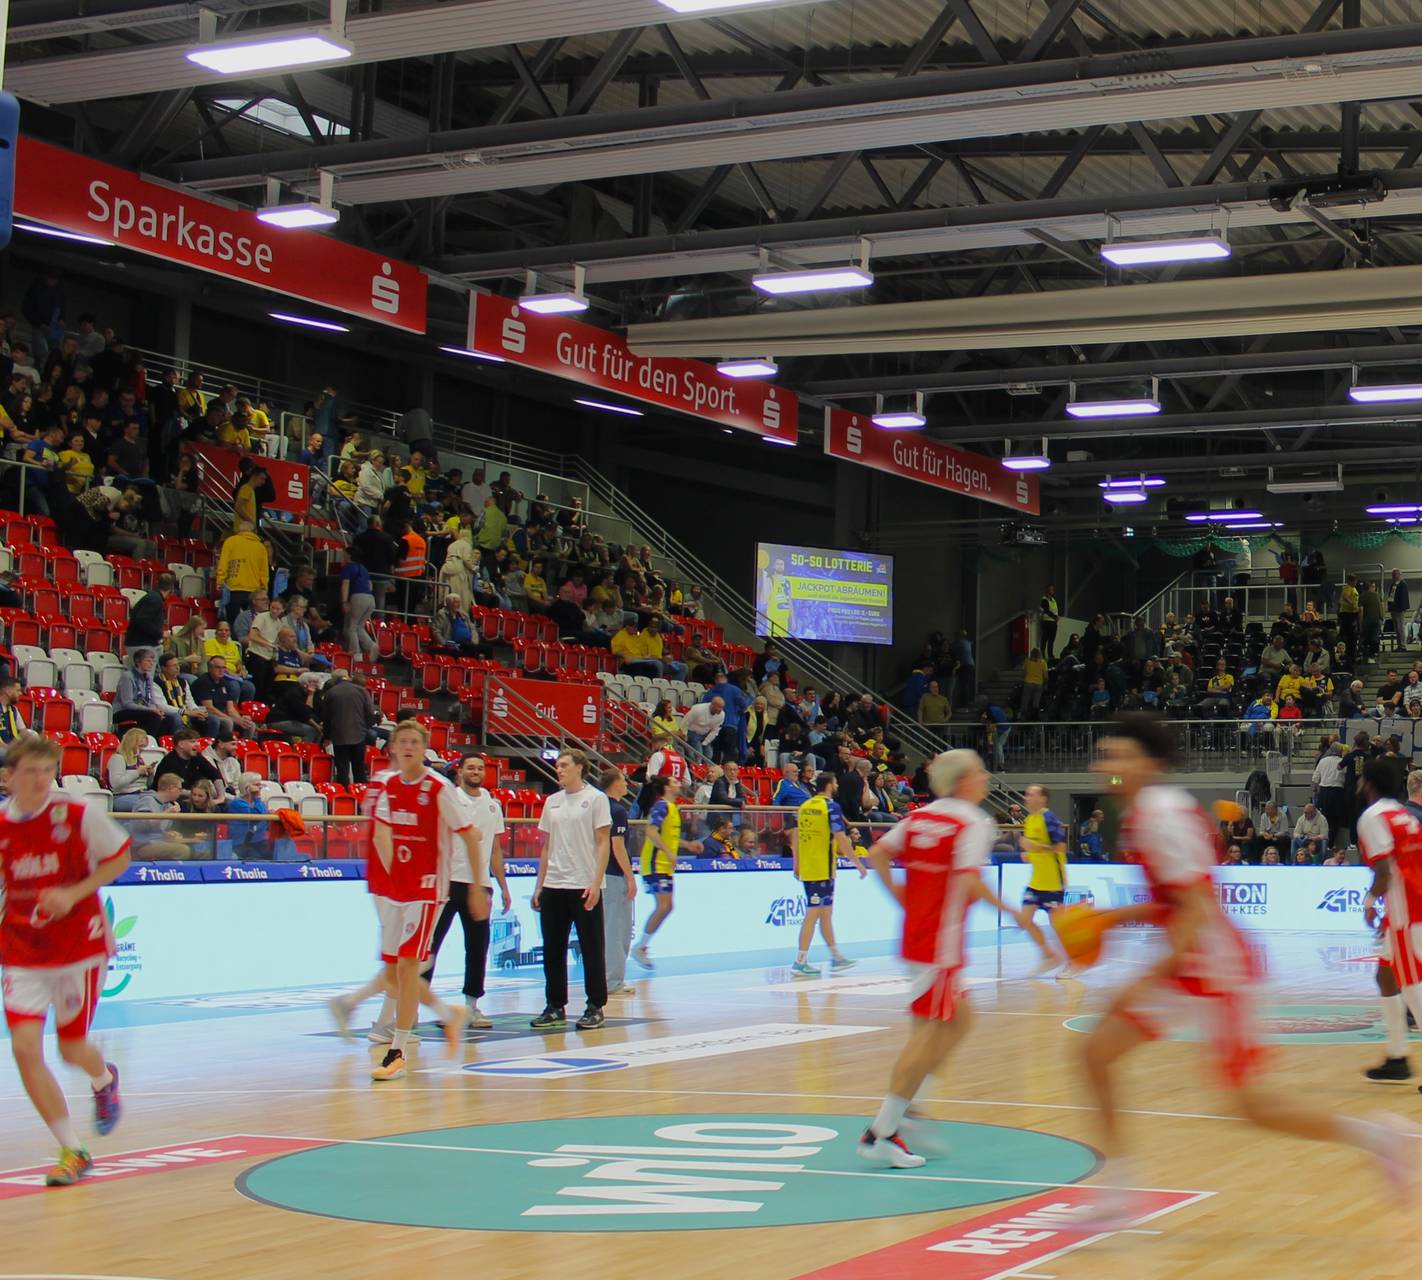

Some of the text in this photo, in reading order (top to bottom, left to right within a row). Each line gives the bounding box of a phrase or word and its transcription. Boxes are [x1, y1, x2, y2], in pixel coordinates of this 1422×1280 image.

[87, 181, 273, 273] Sparkasse
[556, 333, 740, 416] Gut für den Sport.
[893, 439, 992, 493] Gut für Hagen.
[825, 556, 873, 573] LOTTERIE
[797, 581, 834, 593] JACKPOT
[510, 864, 536, 874] Thalia
[716, 860, 737, 870] Thalia
[762, 859, 782, 869] Thalia
[149, 869, 185, 881] Thalia
[233, 867, 268, 880] Thalia
[309, 866, 343, 878] Thalia
[765, 894, 808, 926] GRÄ
[520, 1122, 839, 1216] wilo
